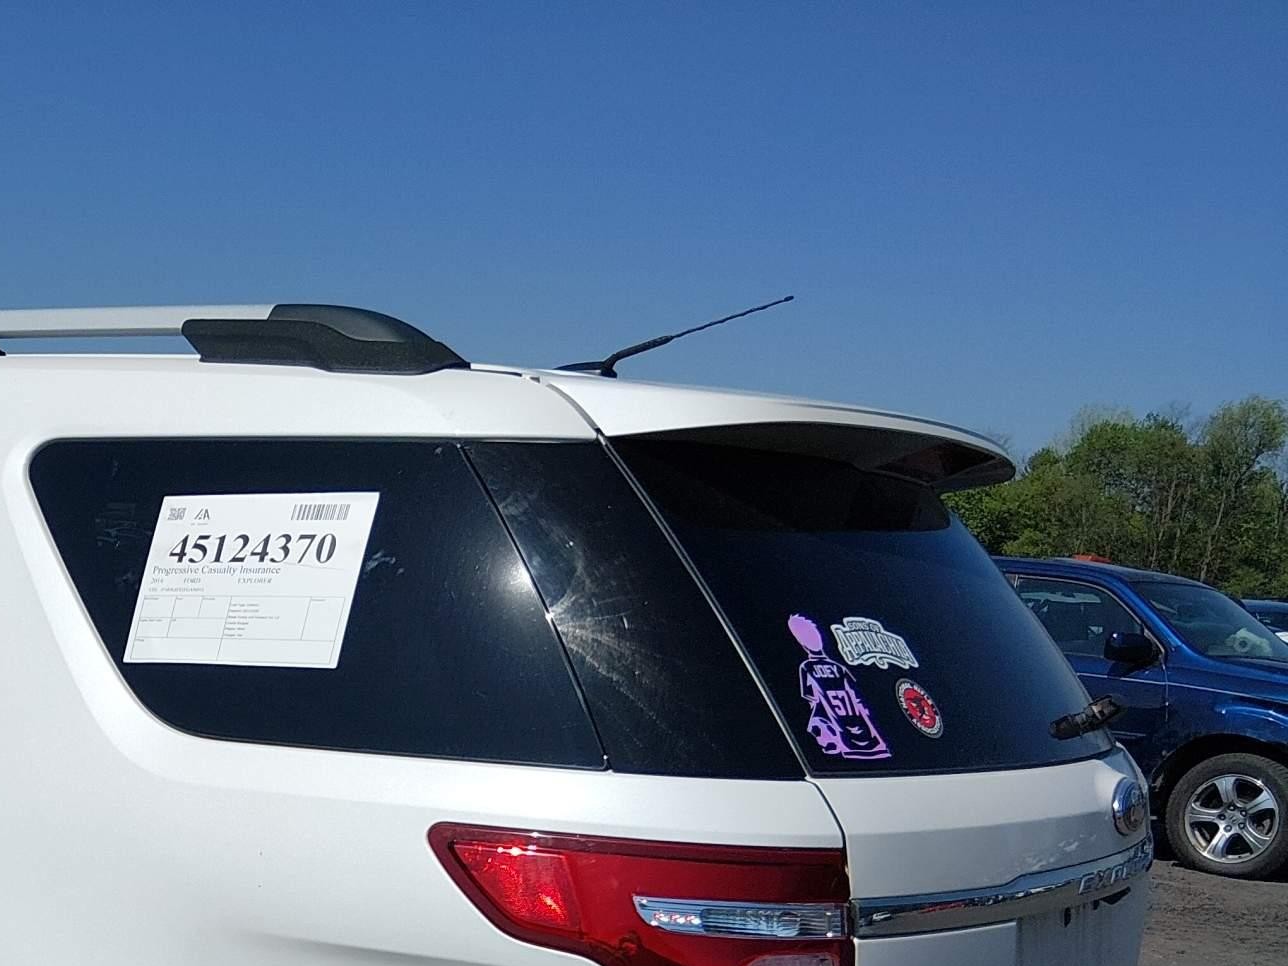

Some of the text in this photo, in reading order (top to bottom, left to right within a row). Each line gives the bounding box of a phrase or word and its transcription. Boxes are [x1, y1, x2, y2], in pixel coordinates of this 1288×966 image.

[169, 532, 337, 564] 45124370
[152, 565, 281, 576] Progressive Casualty Insurance
[812, 664, 840, 678] JOEY
[826, 690, 853, 716] 57
